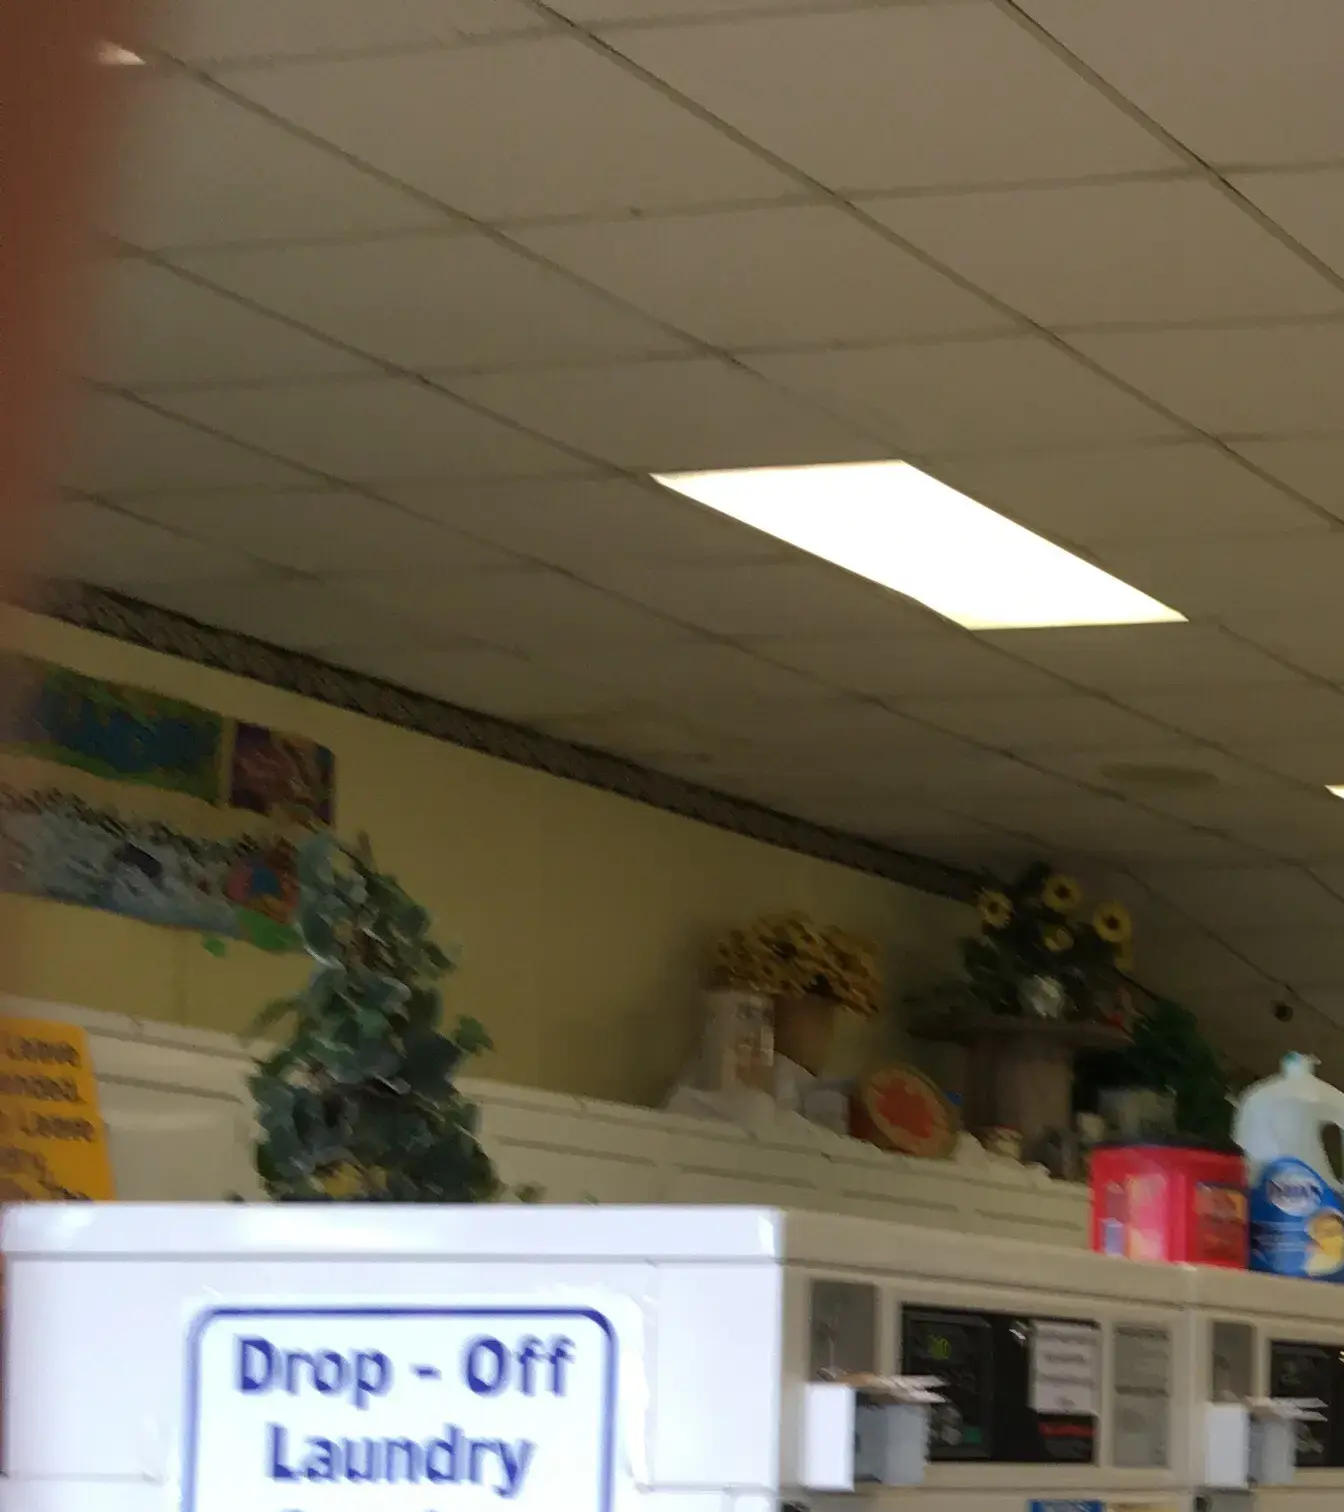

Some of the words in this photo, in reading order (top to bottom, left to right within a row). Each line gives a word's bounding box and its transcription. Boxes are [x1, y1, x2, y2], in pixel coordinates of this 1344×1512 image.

[233, 1334, 394, 1410] Drop
[461, 1333, 576, 1398] Off
[265, 1420, 537, 1499] Laundry
